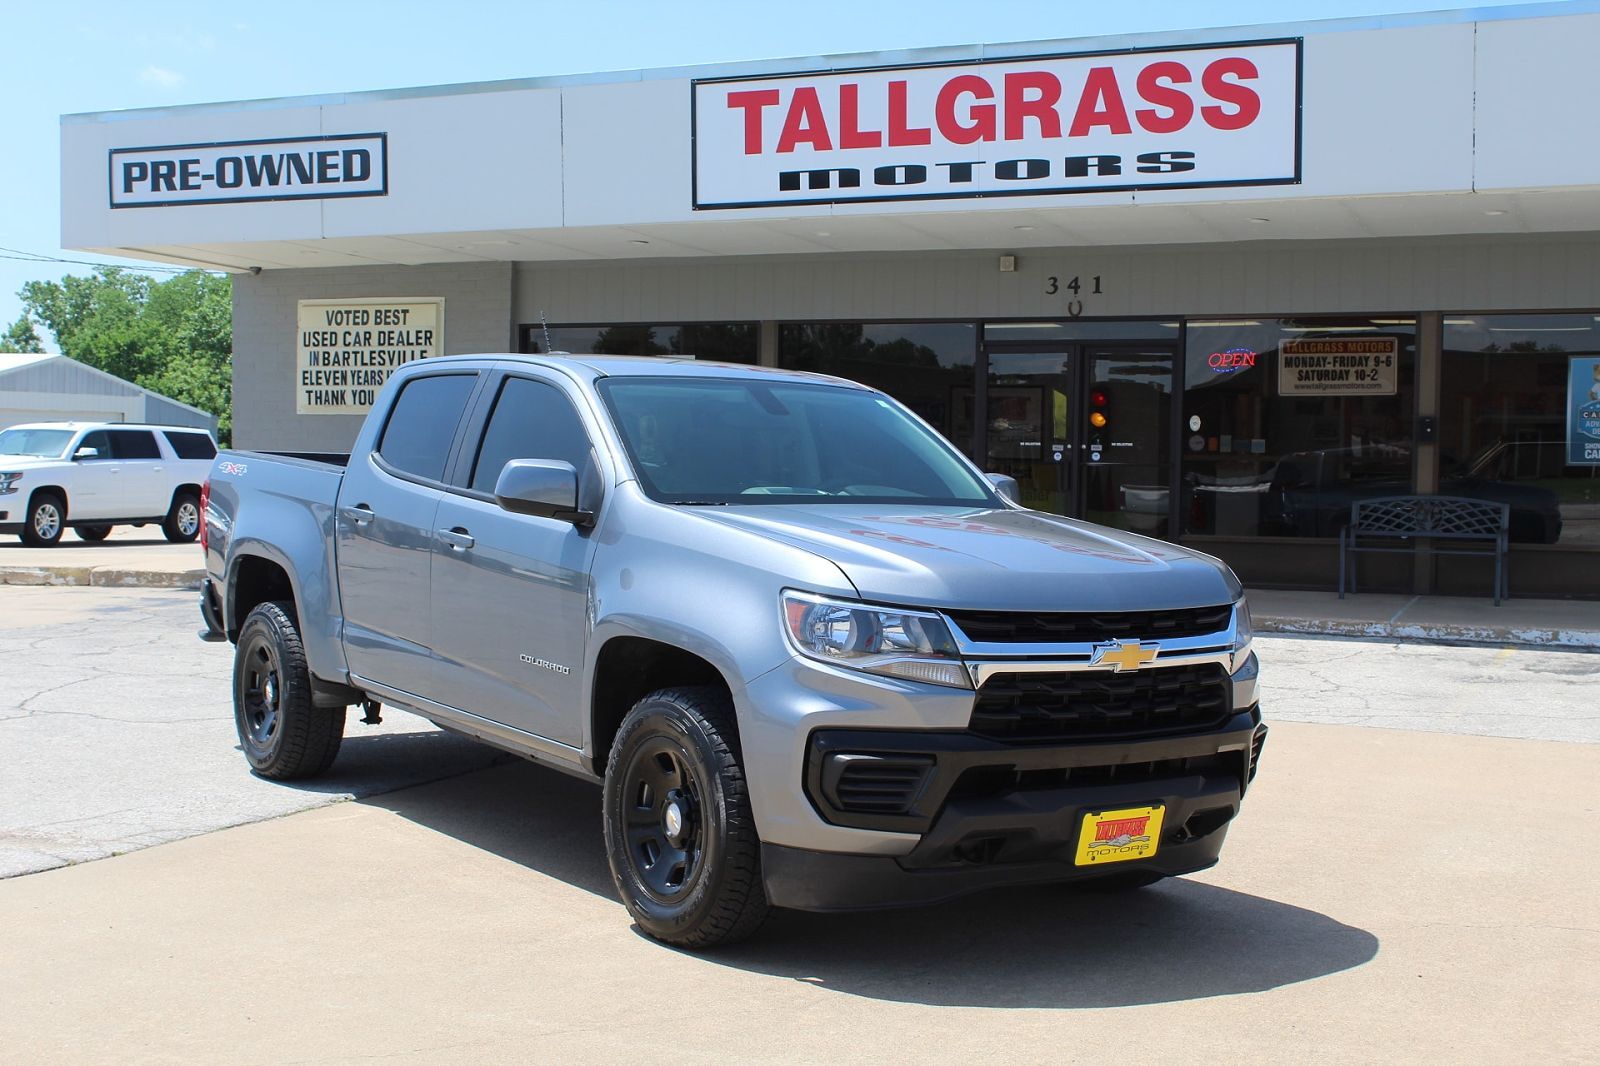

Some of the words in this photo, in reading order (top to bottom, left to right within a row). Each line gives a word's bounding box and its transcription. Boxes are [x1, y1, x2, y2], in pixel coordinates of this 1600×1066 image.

[727, 57, 1261, 155] TALLGRASS
[122, 148, 371, 194] PRE-OWNED
[779, 151, 1196, 192] MOTORS
[326, 310, 370, 326] VOTED
[374, 309, 409, 326] BEST
[303, 331, 338, 347] USED
[343, 331, 372, 347] CAR
[377, 330, 433, 346] DEALER
[1285, 342, 1345, 353] TALLGRASS
[1348, 342, 1392, 352] MOTORS
[309, 351, 319, 366] IN
[1208, 352, 1256, 367] OPEN
[1284, 355, 1370, 368] MONDAY-FRIDAY
[1373, 355, 1392, 367] 9-6
[302, 370, 347, 386] ELEVEN
[351, 370, 384, 386] YEARS
[1297, 369, 1350, 381] SATURDAY
[1354, 368, 1378, 381] 10-2
[305, 390, 346, 406] THANK
[352, 390, 375, 405] YOU
[519, 653, 570, 675] COLORADO
[1087, 844, 1149, 856] MOTORS
